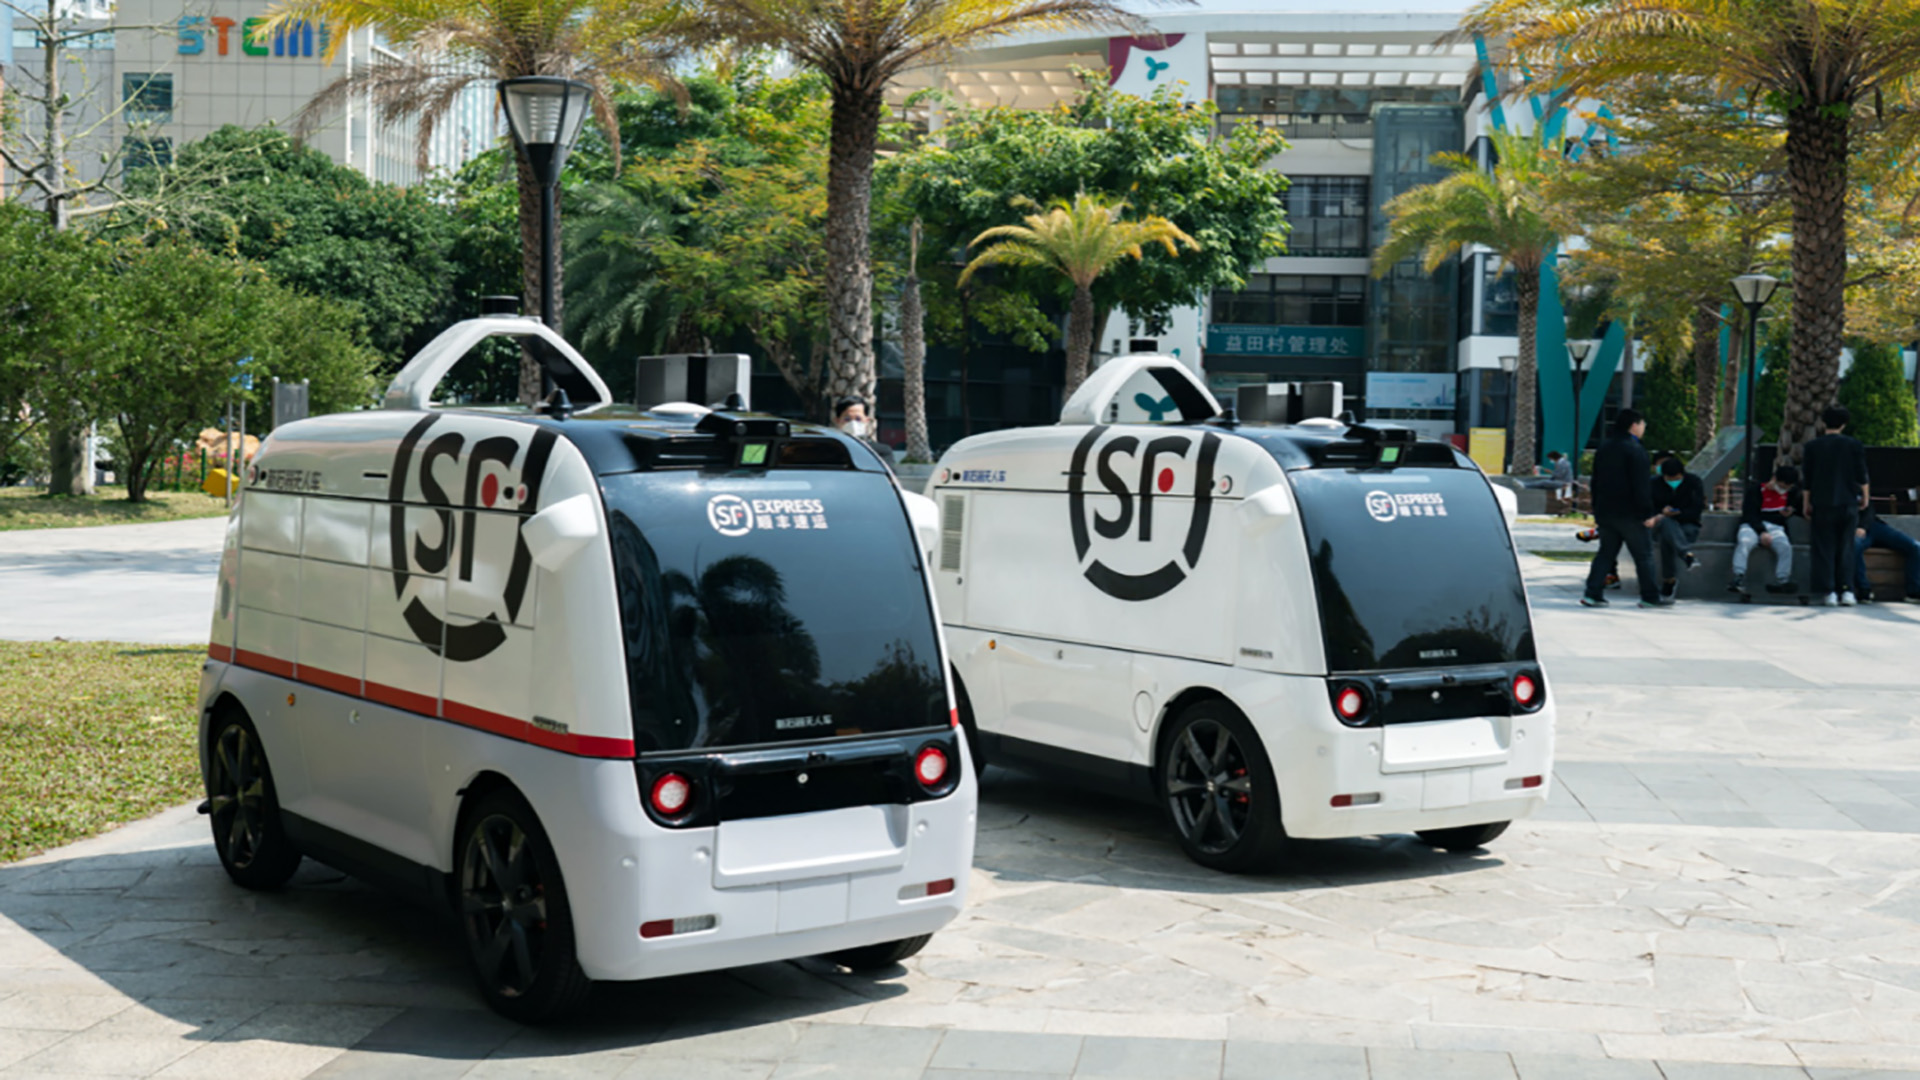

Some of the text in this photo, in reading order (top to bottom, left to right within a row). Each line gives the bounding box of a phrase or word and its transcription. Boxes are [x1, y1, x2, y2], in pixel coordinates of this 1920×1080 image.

[1226, 335, 1348, 354] 益田村管理处
[1395, 493, 1444, 504] EXPRESS
[752, 499, 824, 514] EXPRESS
